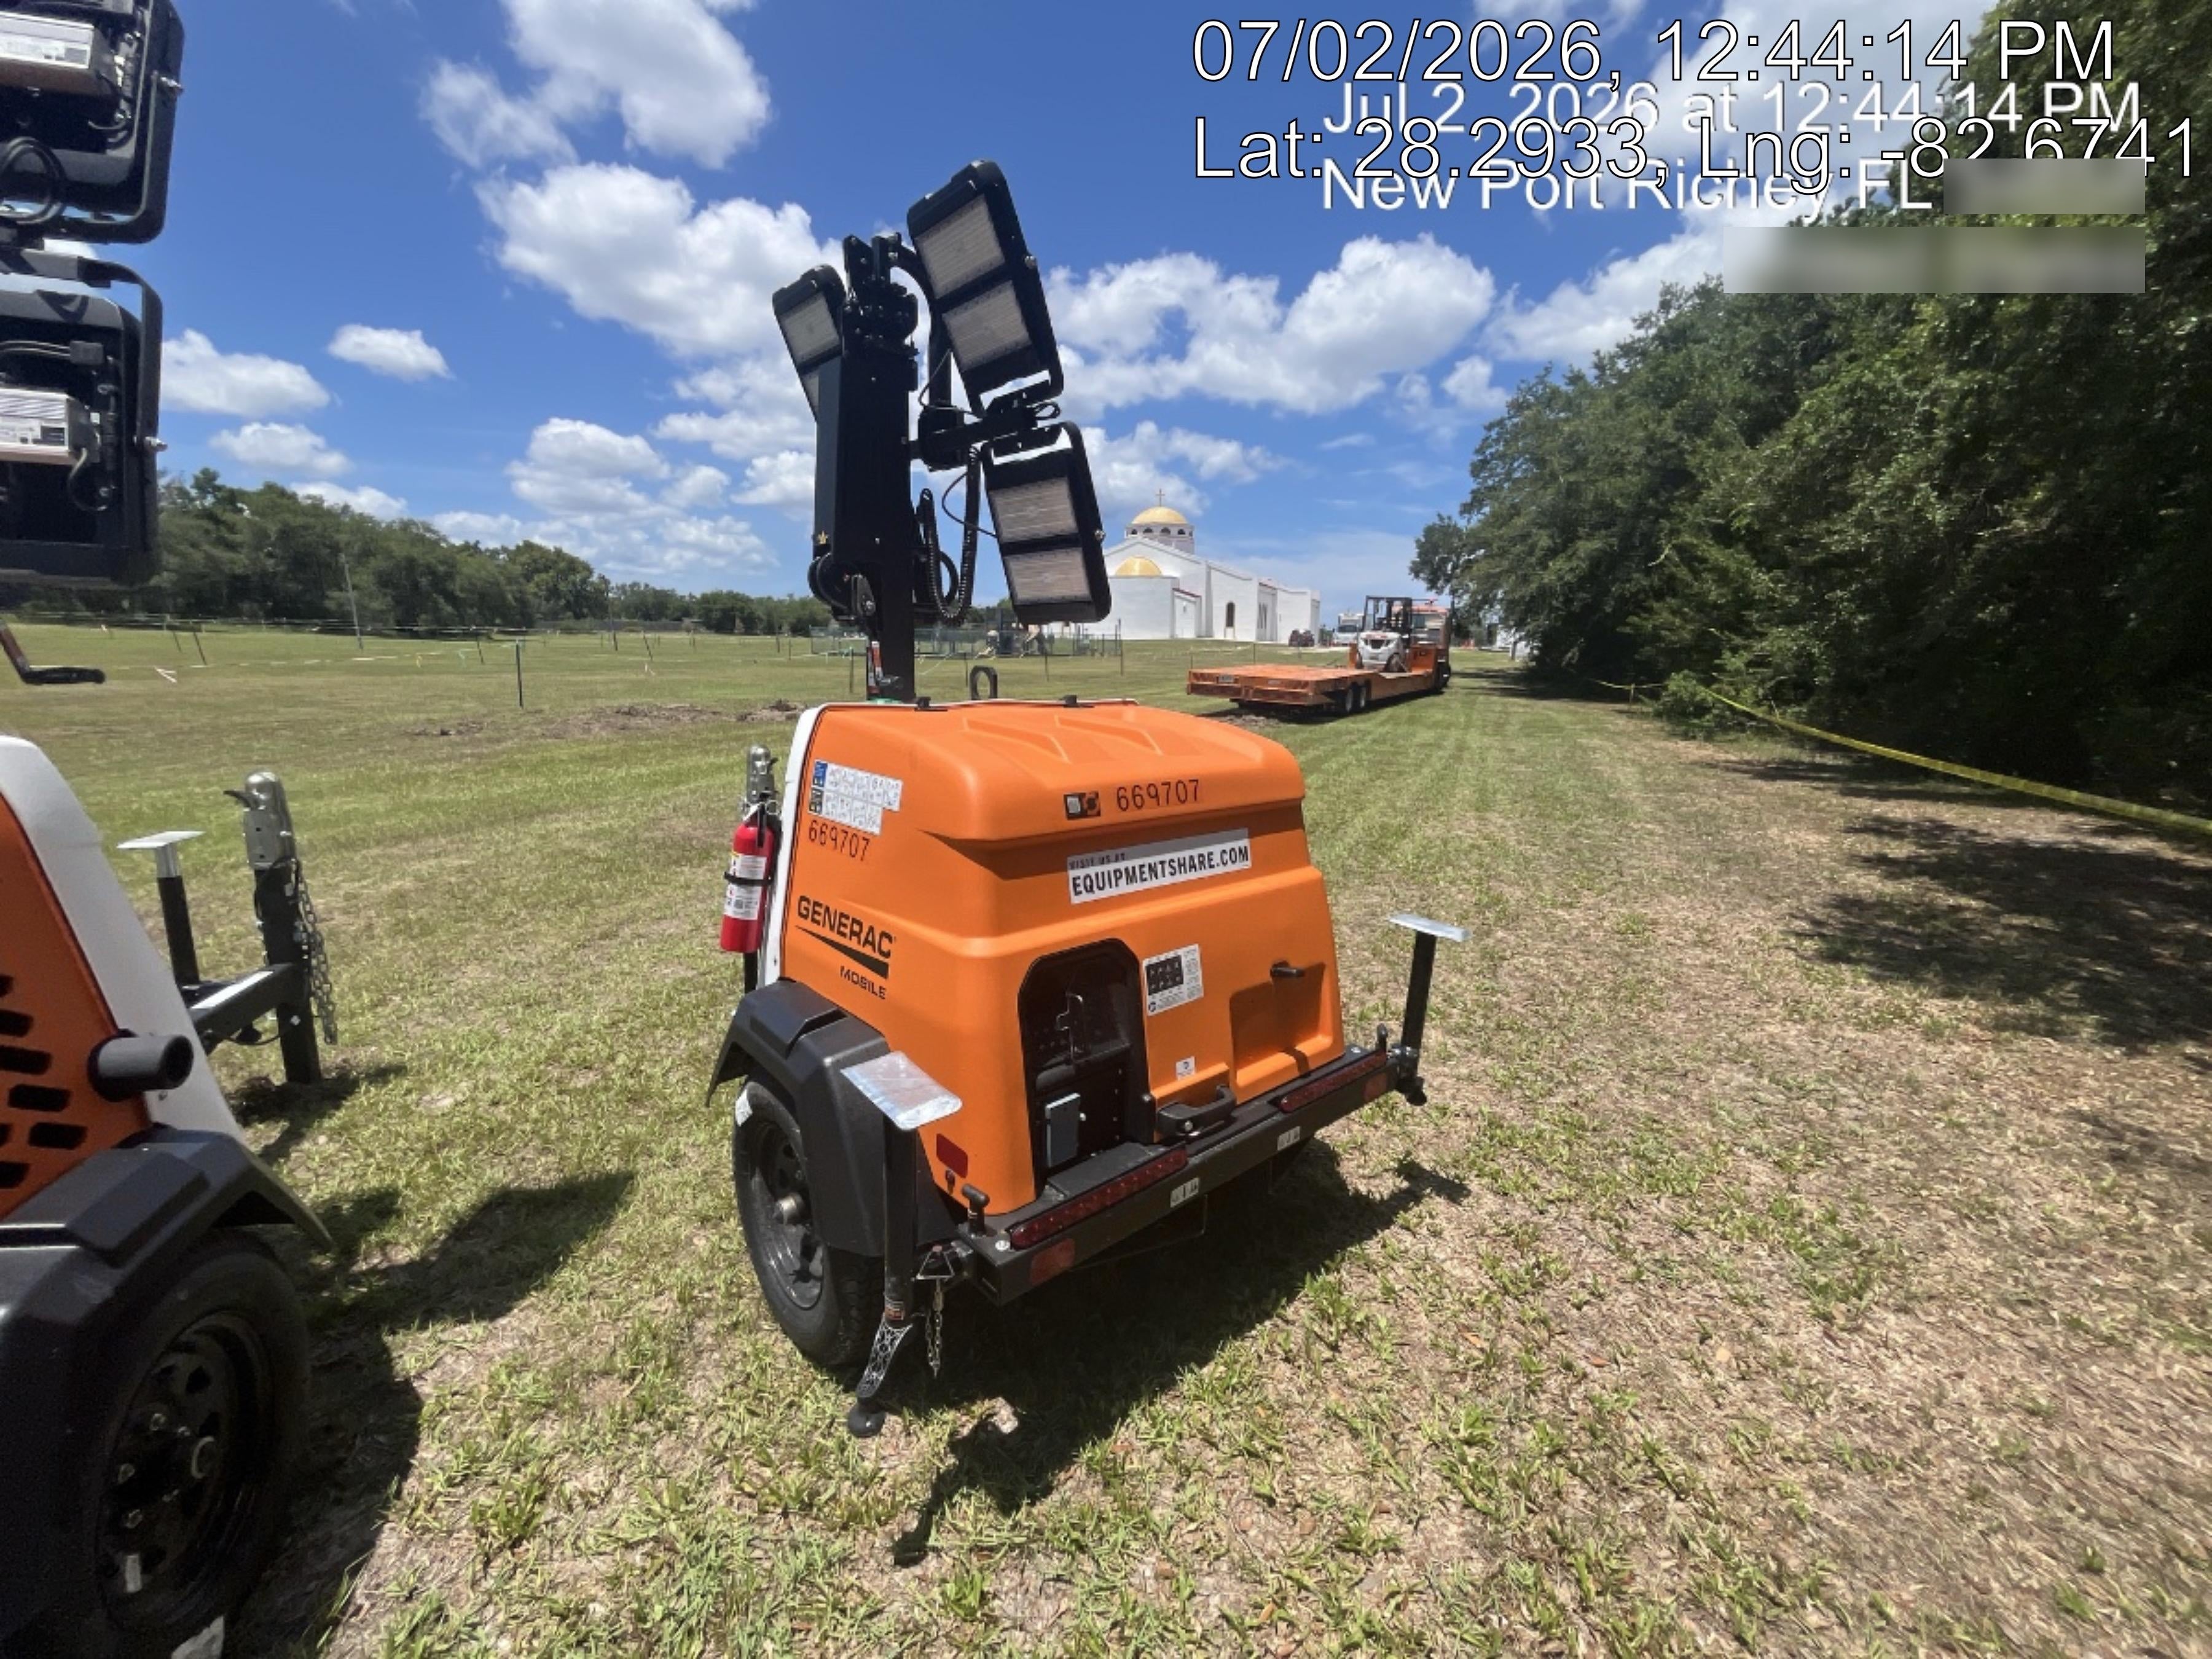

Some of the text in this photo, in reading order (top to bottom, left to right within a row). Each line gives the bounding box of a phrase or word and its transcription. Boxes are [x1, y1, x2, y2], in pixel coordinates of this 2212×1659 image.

[1116, 779, 1199, 812] 669707
[809, 820, 870, 861] 669707
[1072, 845, 1249, 896] EQUIPMENTSHARE.COM
[798, 895, 893, 959] GENERAC
[840, 965, 887, 1000] MOBILE
